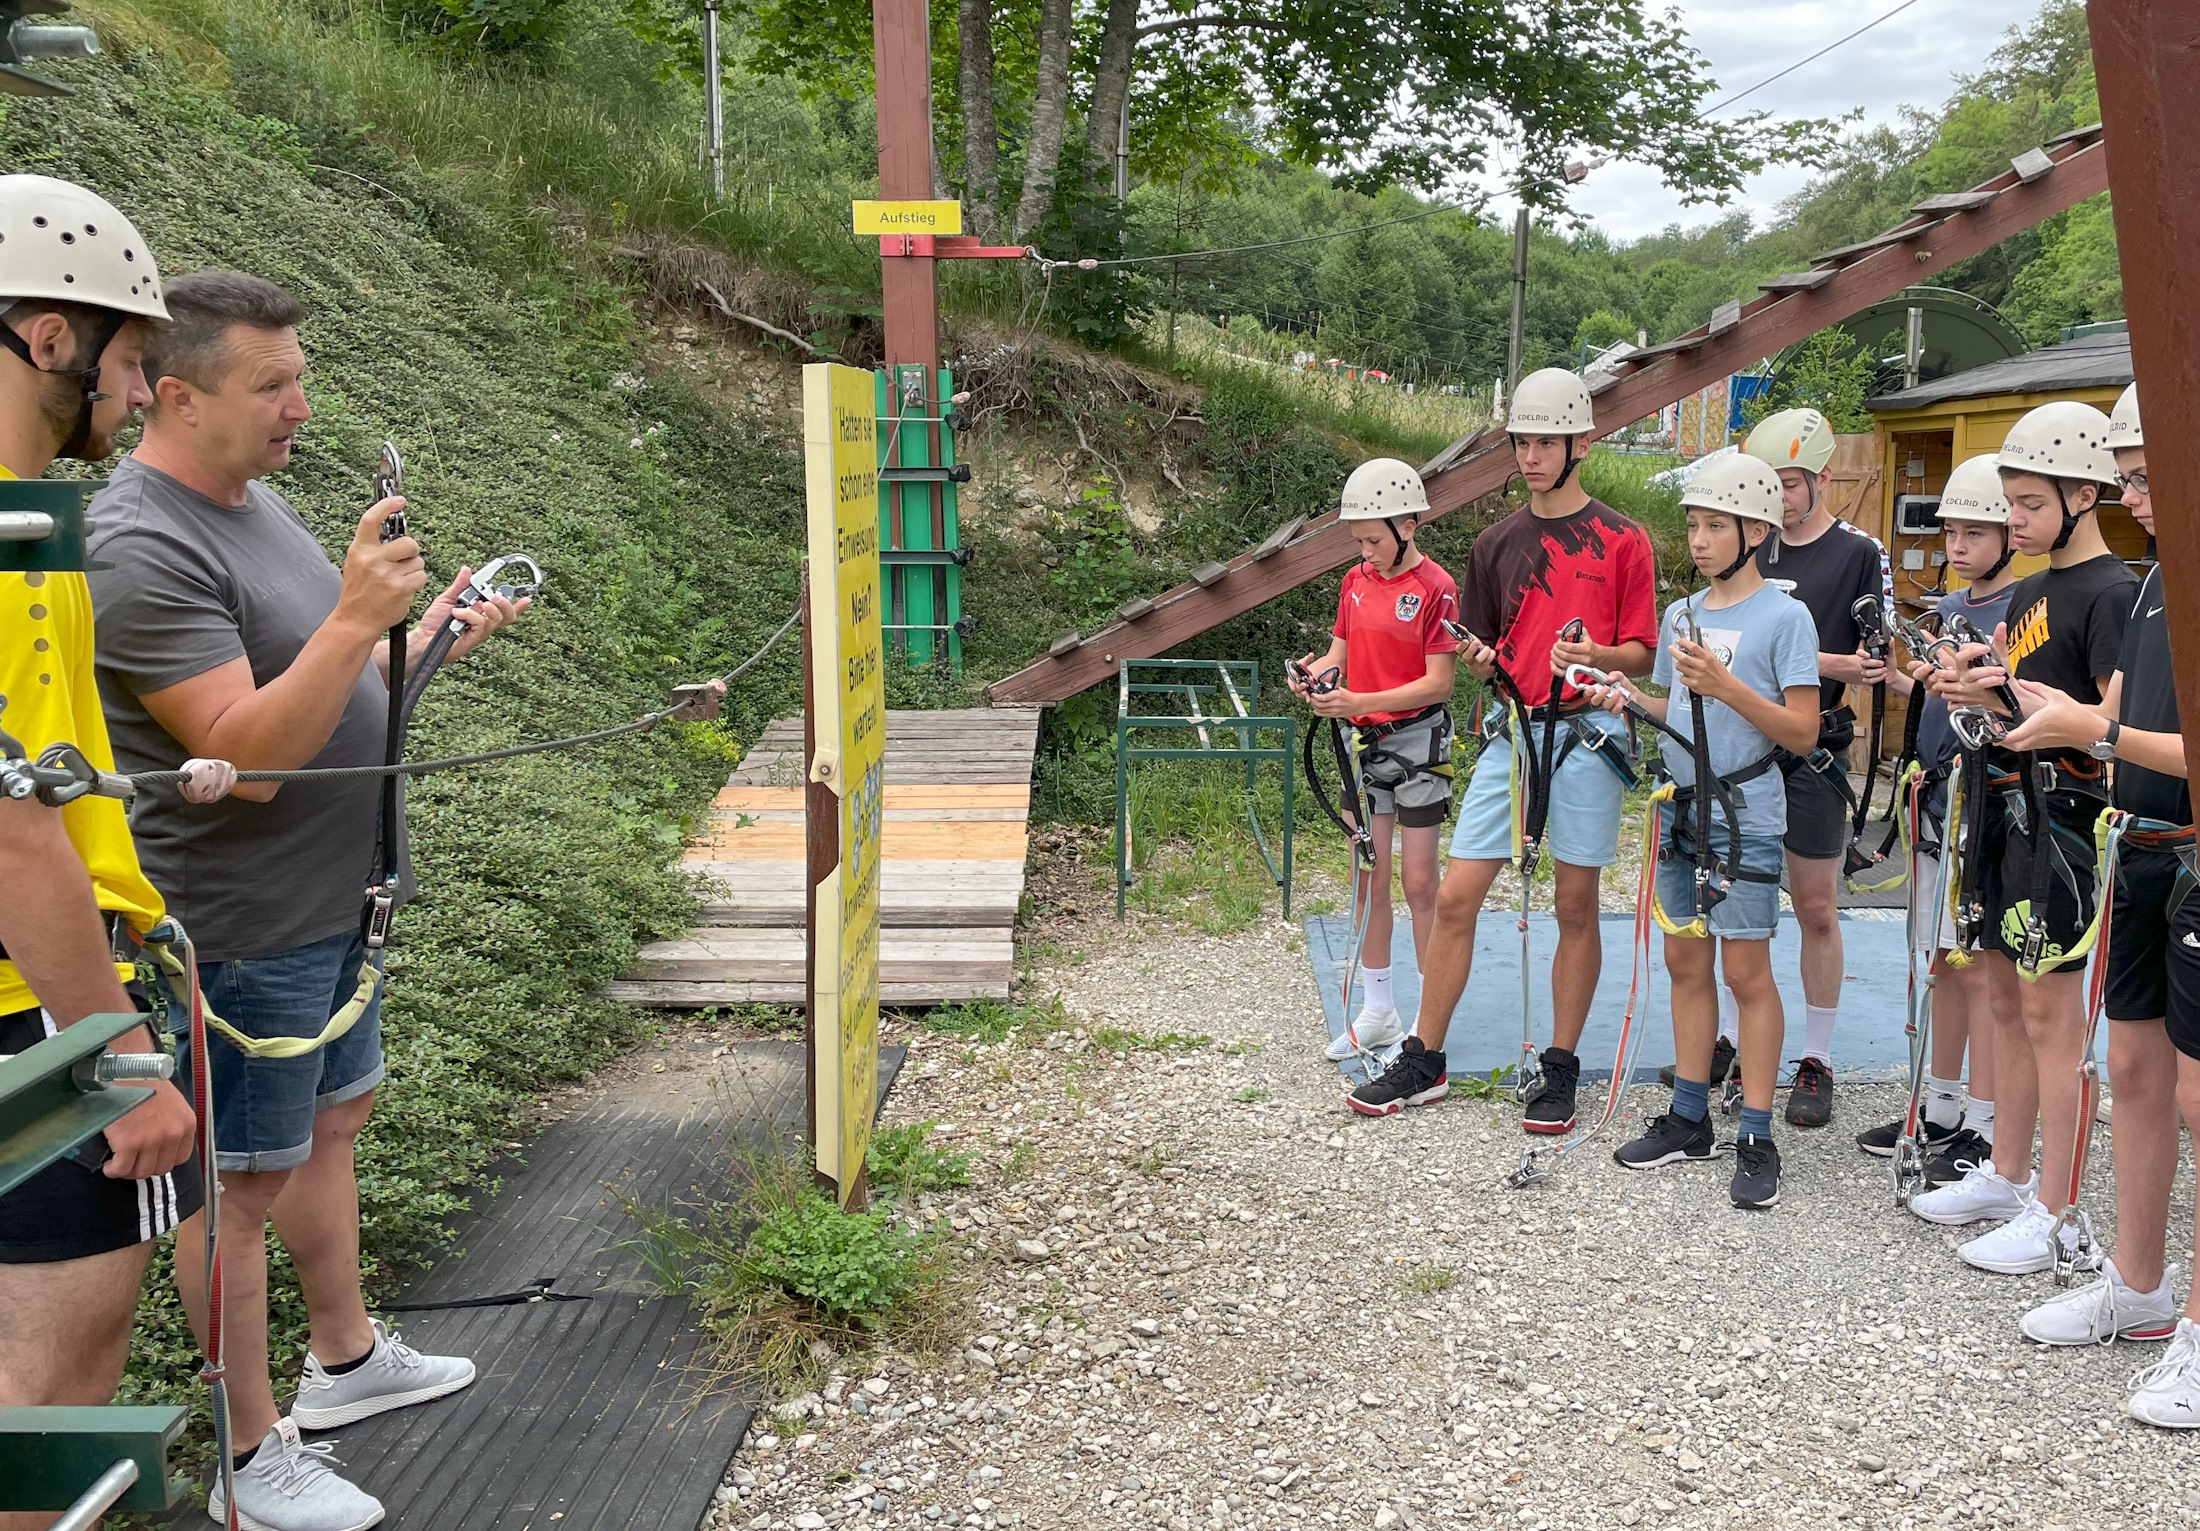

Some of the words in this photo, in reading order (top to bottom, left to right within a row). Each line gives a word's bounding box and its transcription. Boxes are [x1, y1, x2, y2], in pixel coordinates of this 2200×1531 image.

[879, 212, 936, 226] Aufstieg
[839, 406, 863, 442] Hatten
[863, 409, 872, 442] sie
[1517, 414, 1549, 422] EDELRID
[839, 466, 863, 503] schon
[863, 464, 875, 498] eine
[1945, 497, 1979, 507] EDELRID
[837, 516, 878, 564] Einweisung?
[851, 582, 872, 628] Nein?
[848, 654, 864, 693] Bitte
[864, 642, 877, 679] hier
[852, 692, 878, 747] warten!
[842, 955, 855, 996] des
[843, 1012, 853, 1054] ist
